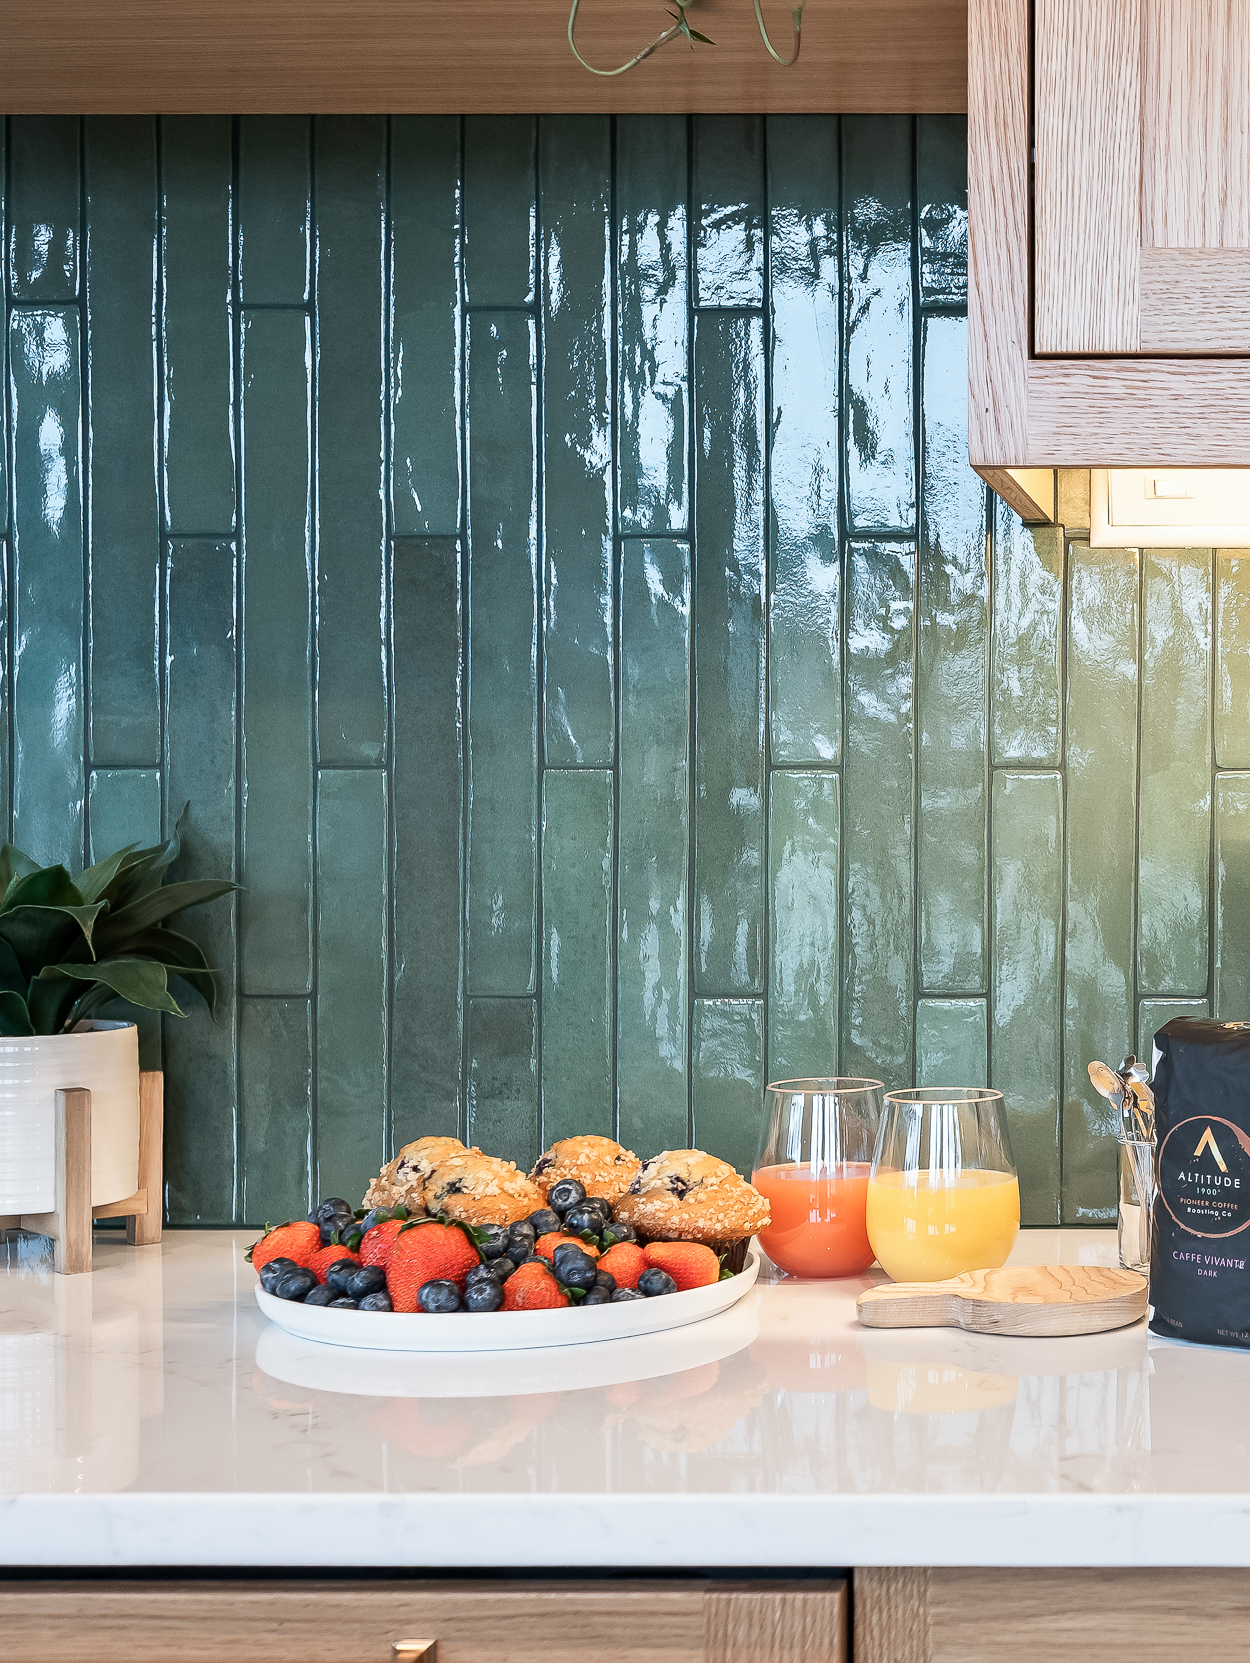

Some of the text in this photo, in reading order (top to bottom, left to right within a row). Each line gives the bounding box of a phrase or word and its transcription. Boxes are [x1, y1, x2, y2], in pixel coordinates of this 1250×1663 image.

[1177, 1171, 1241, 1188] ALTITUDE
[1179, 1197, 1239, 1211] PIONEER COFFEE
[1187, 1207, 1219, 1217] Roasting
[1172, 1250, 1202, 1264] CAFFE
[1197, 1268, 1218, 1278] DARK
